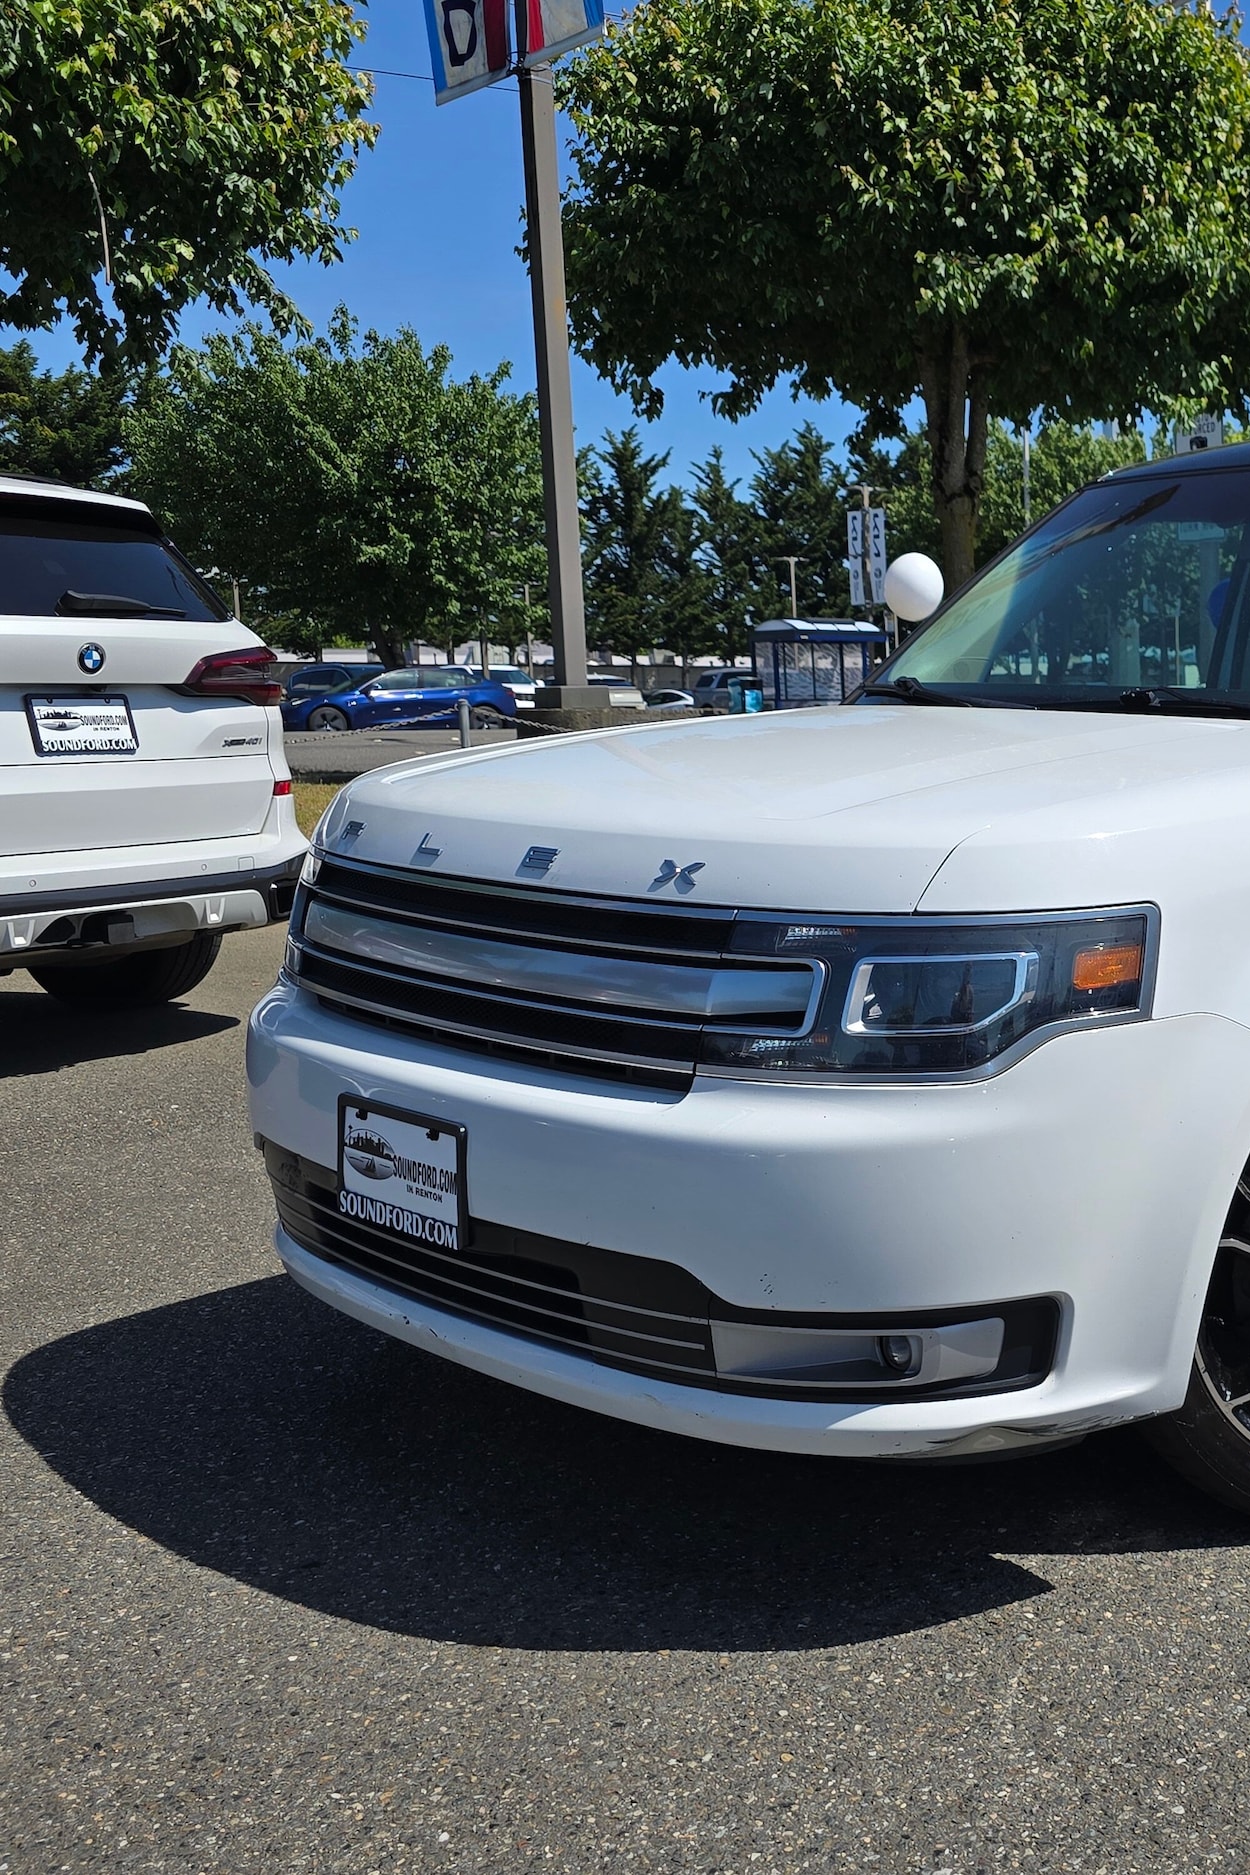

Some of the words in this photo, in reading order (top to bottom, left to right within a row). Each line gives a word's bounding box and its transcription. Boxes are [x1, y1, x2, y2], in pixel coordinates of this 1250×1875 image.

[42, 738, 137, 751] SOUNDFORD.COM
[342, 820, 707, 886] FLEX
[393, 1154, 457, 1195] SOUNDFORD.COM
[415, 1187, 443, 1203] RENTON
[340, 1190, 458, 1250] SOUNDFORD.COM
